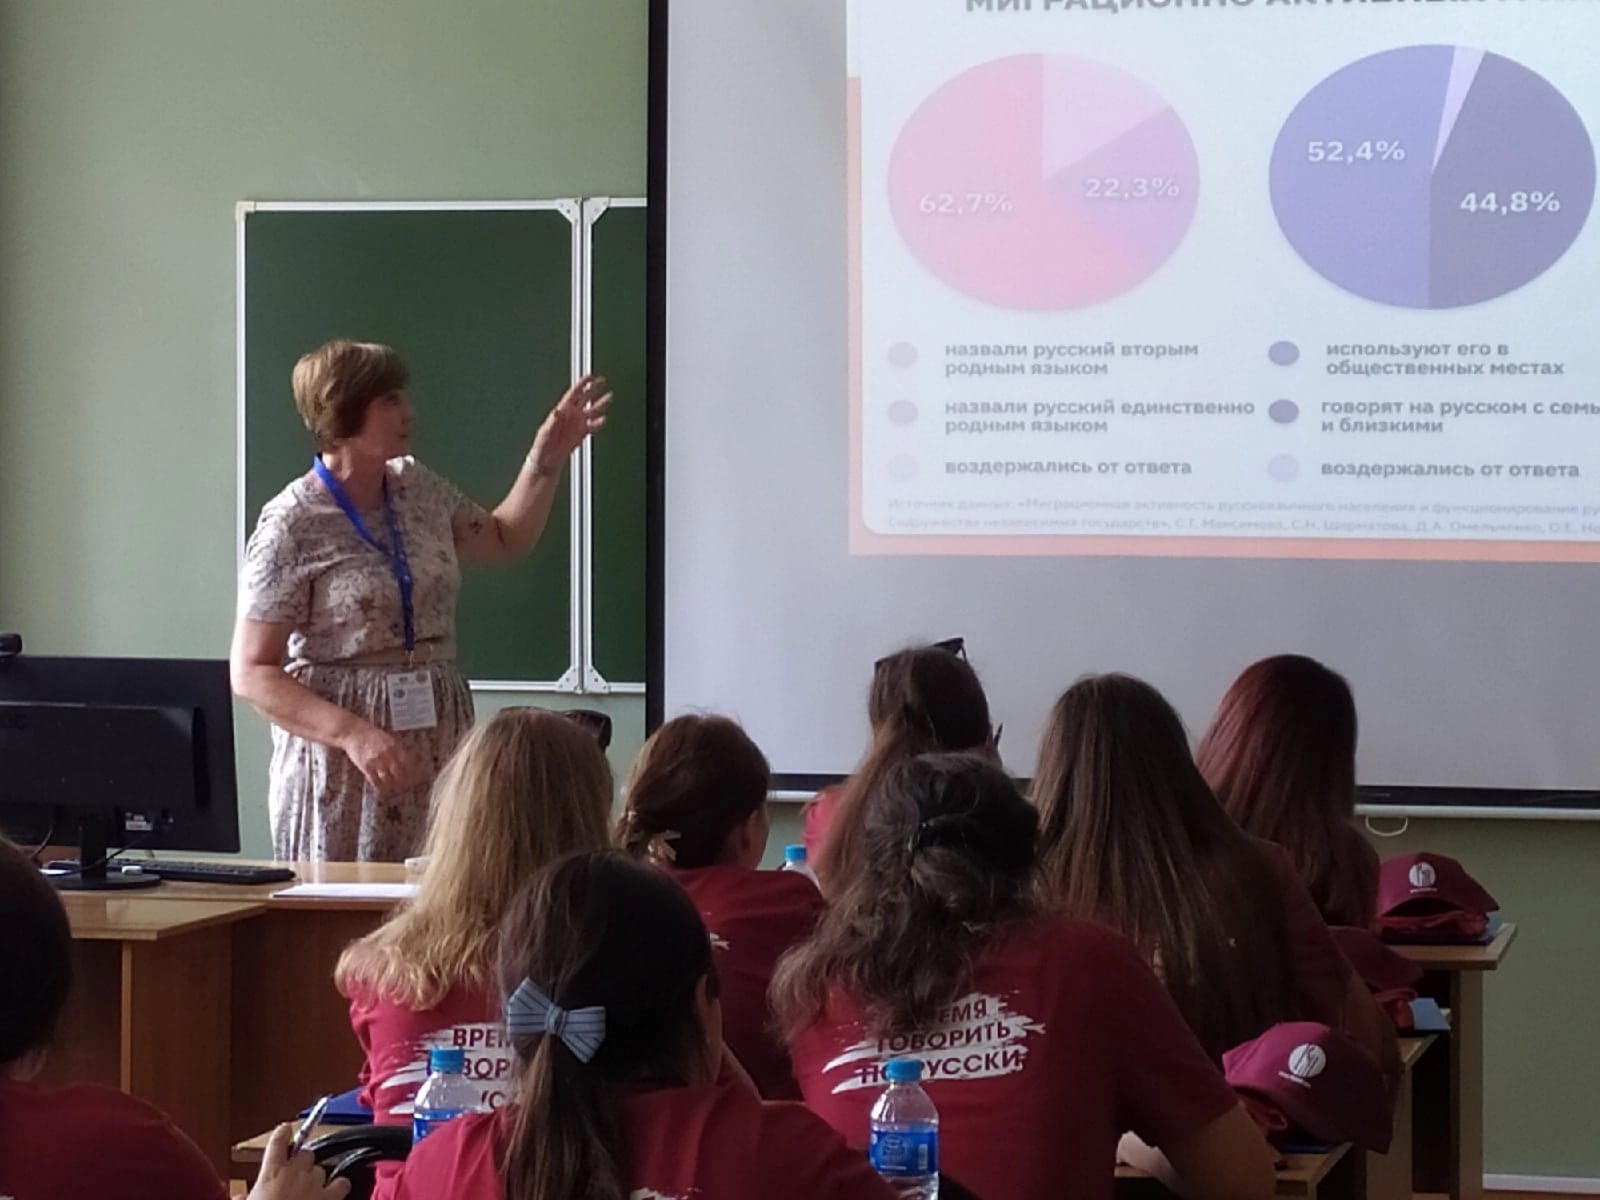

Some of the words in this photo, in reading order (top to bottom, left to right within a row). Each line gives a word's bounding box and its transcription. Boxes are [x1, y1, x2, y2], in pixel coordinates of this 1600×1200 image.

[1307, 141, 1406, 164] 52,4%
[1085, 177, 1180, 200] 22,3%
[919, 193, 1013, 215] 62,7%
[1460, 191, 1561, 216] 44,8%
[945, 344, 1028, 357] назвали
[1033, 342, 1115, 360] русский
[1121, 344, 1199, 359] вторым
[1326, 343, 1451, 359] используют
[1457, 344, 1492, 356] его
[1497, 345, 1509, 356] в
[945, 362, 1026, 376] родным
[1031, 362, 1108, 375] языком
[1326, 360, 1484, 376] общественных
[1490, 363, 1565, 375] местах
[945, 402, 1028, 414] назвали
[1033, 399, 1115, 416] русский
[1121, 402, 1256, 416] единственно
[1321, 401, 1404, 416] говорят
[1409, 402, 1435, 414] на
[1439, 402, 1527, 419] русском
[1533, 402, 1545, 414] с
[945, 419, 1026, 434] родным
[1031, 420, 1108, 432] языком
[1321, 420, 1333, 432] и
[1340, 418, 1443, 433] близкими
[945, 461, 1092, 475] воздержались
[1098, 463, 1119, 474] от
[1124, 463, 1193, 474] ответа
[1321, 462, 1475, 478] воздержались
[1480, 464, 1503, 476] от
[1509, 464, 1580, 477] ответа
[453, 1028, 512, 1048] ВРЕ
